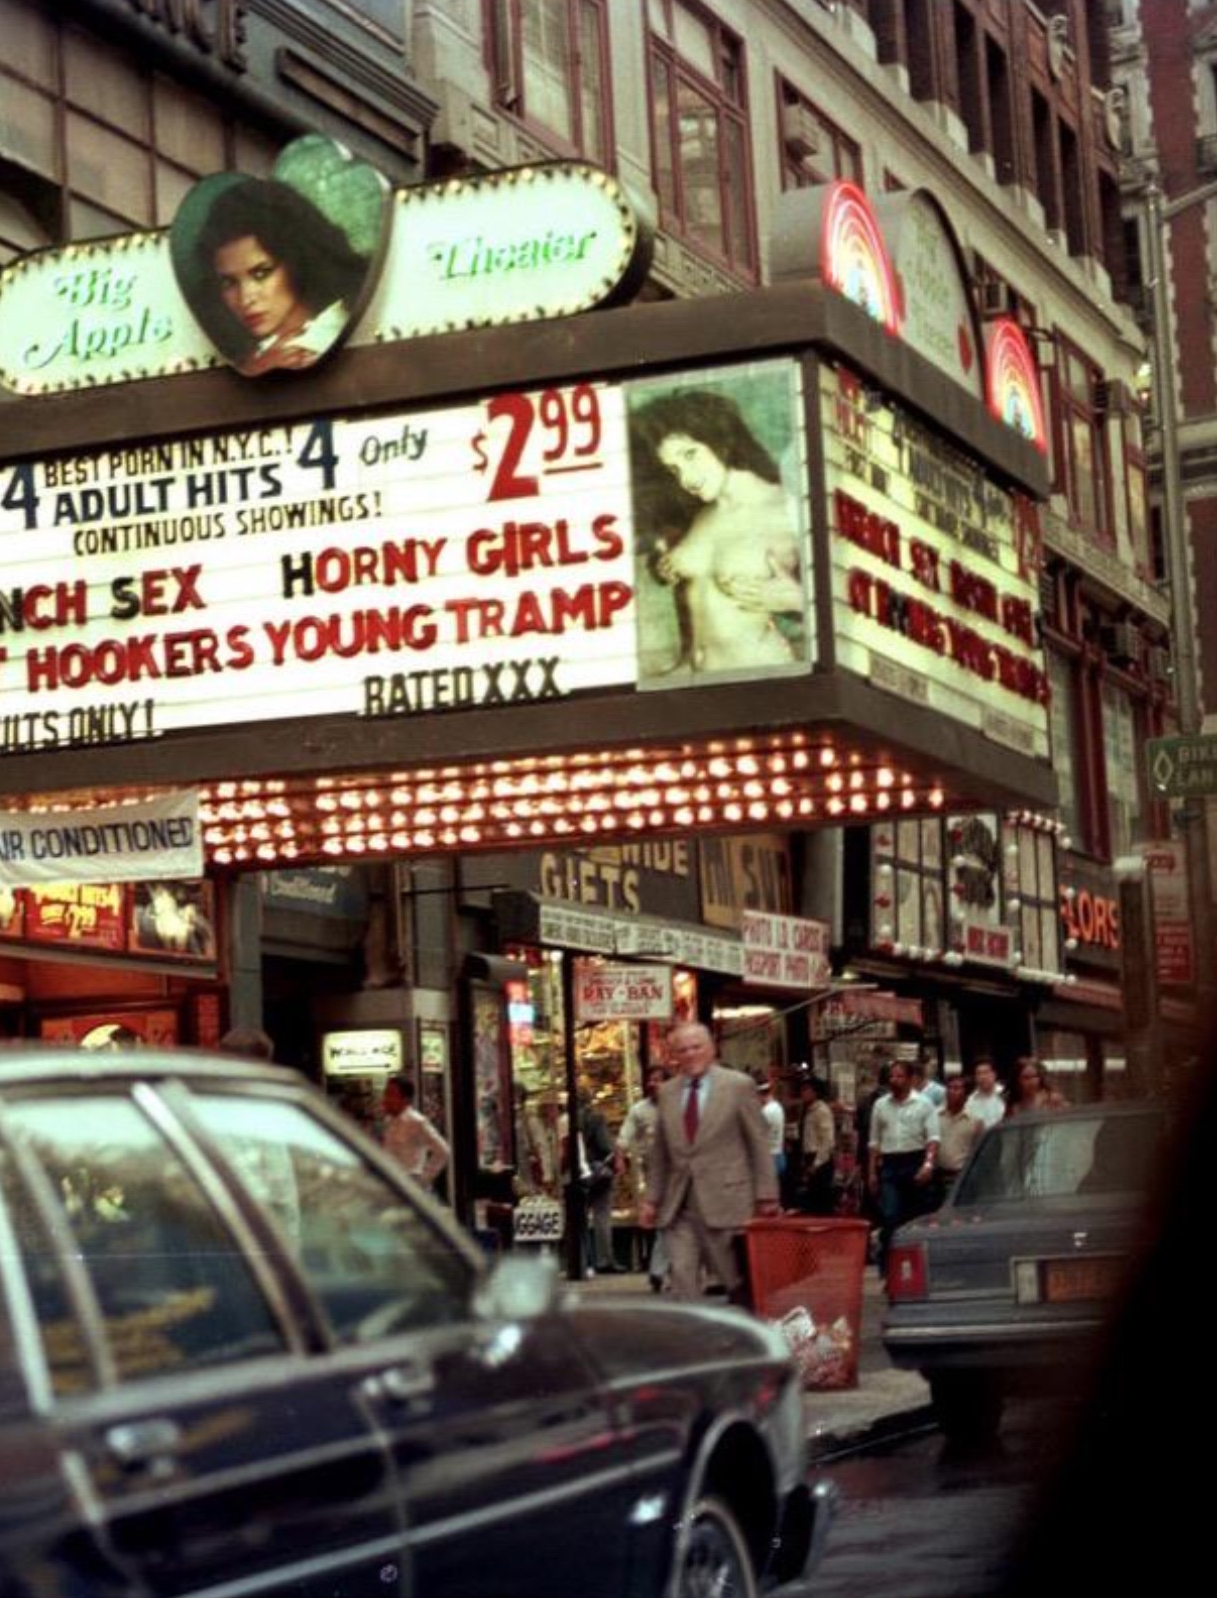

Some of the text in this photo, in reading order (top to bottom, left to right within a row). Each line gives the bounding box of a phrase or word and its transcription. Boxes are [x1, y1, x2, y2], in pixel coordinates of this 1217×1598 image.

[425, 229, 598, 283] Theater
[51, 265, 140, 310] Big
[21, 307, 175, 369] Apple
[44, 453, 110, 488] BEST
[109, 445, 173, 480] PORN
[180, 438, 205, 468] IN
[296, 421, 429, 491] 4 Only
[0, 463, 41, 530] 4
[52, 464, 283, 527] ADULT HITS
[73, 491, 383, 557] CONTINUOUS SHOWINGS!
[281, 514, 625, 599] HORNY GIRLS
[110, 563, 207, 620] SEX
[262, 581, 635, 667] YOUNG TRAMP
[26, 624, 256, 693] HOOKERS
[364, 656, 562, 718] RATED XXX
[69, 698, 156, 747] ONLY!
[30, 816, 194, 860] CONDITIONED
[540, 852, 641, 915] GIFTS
